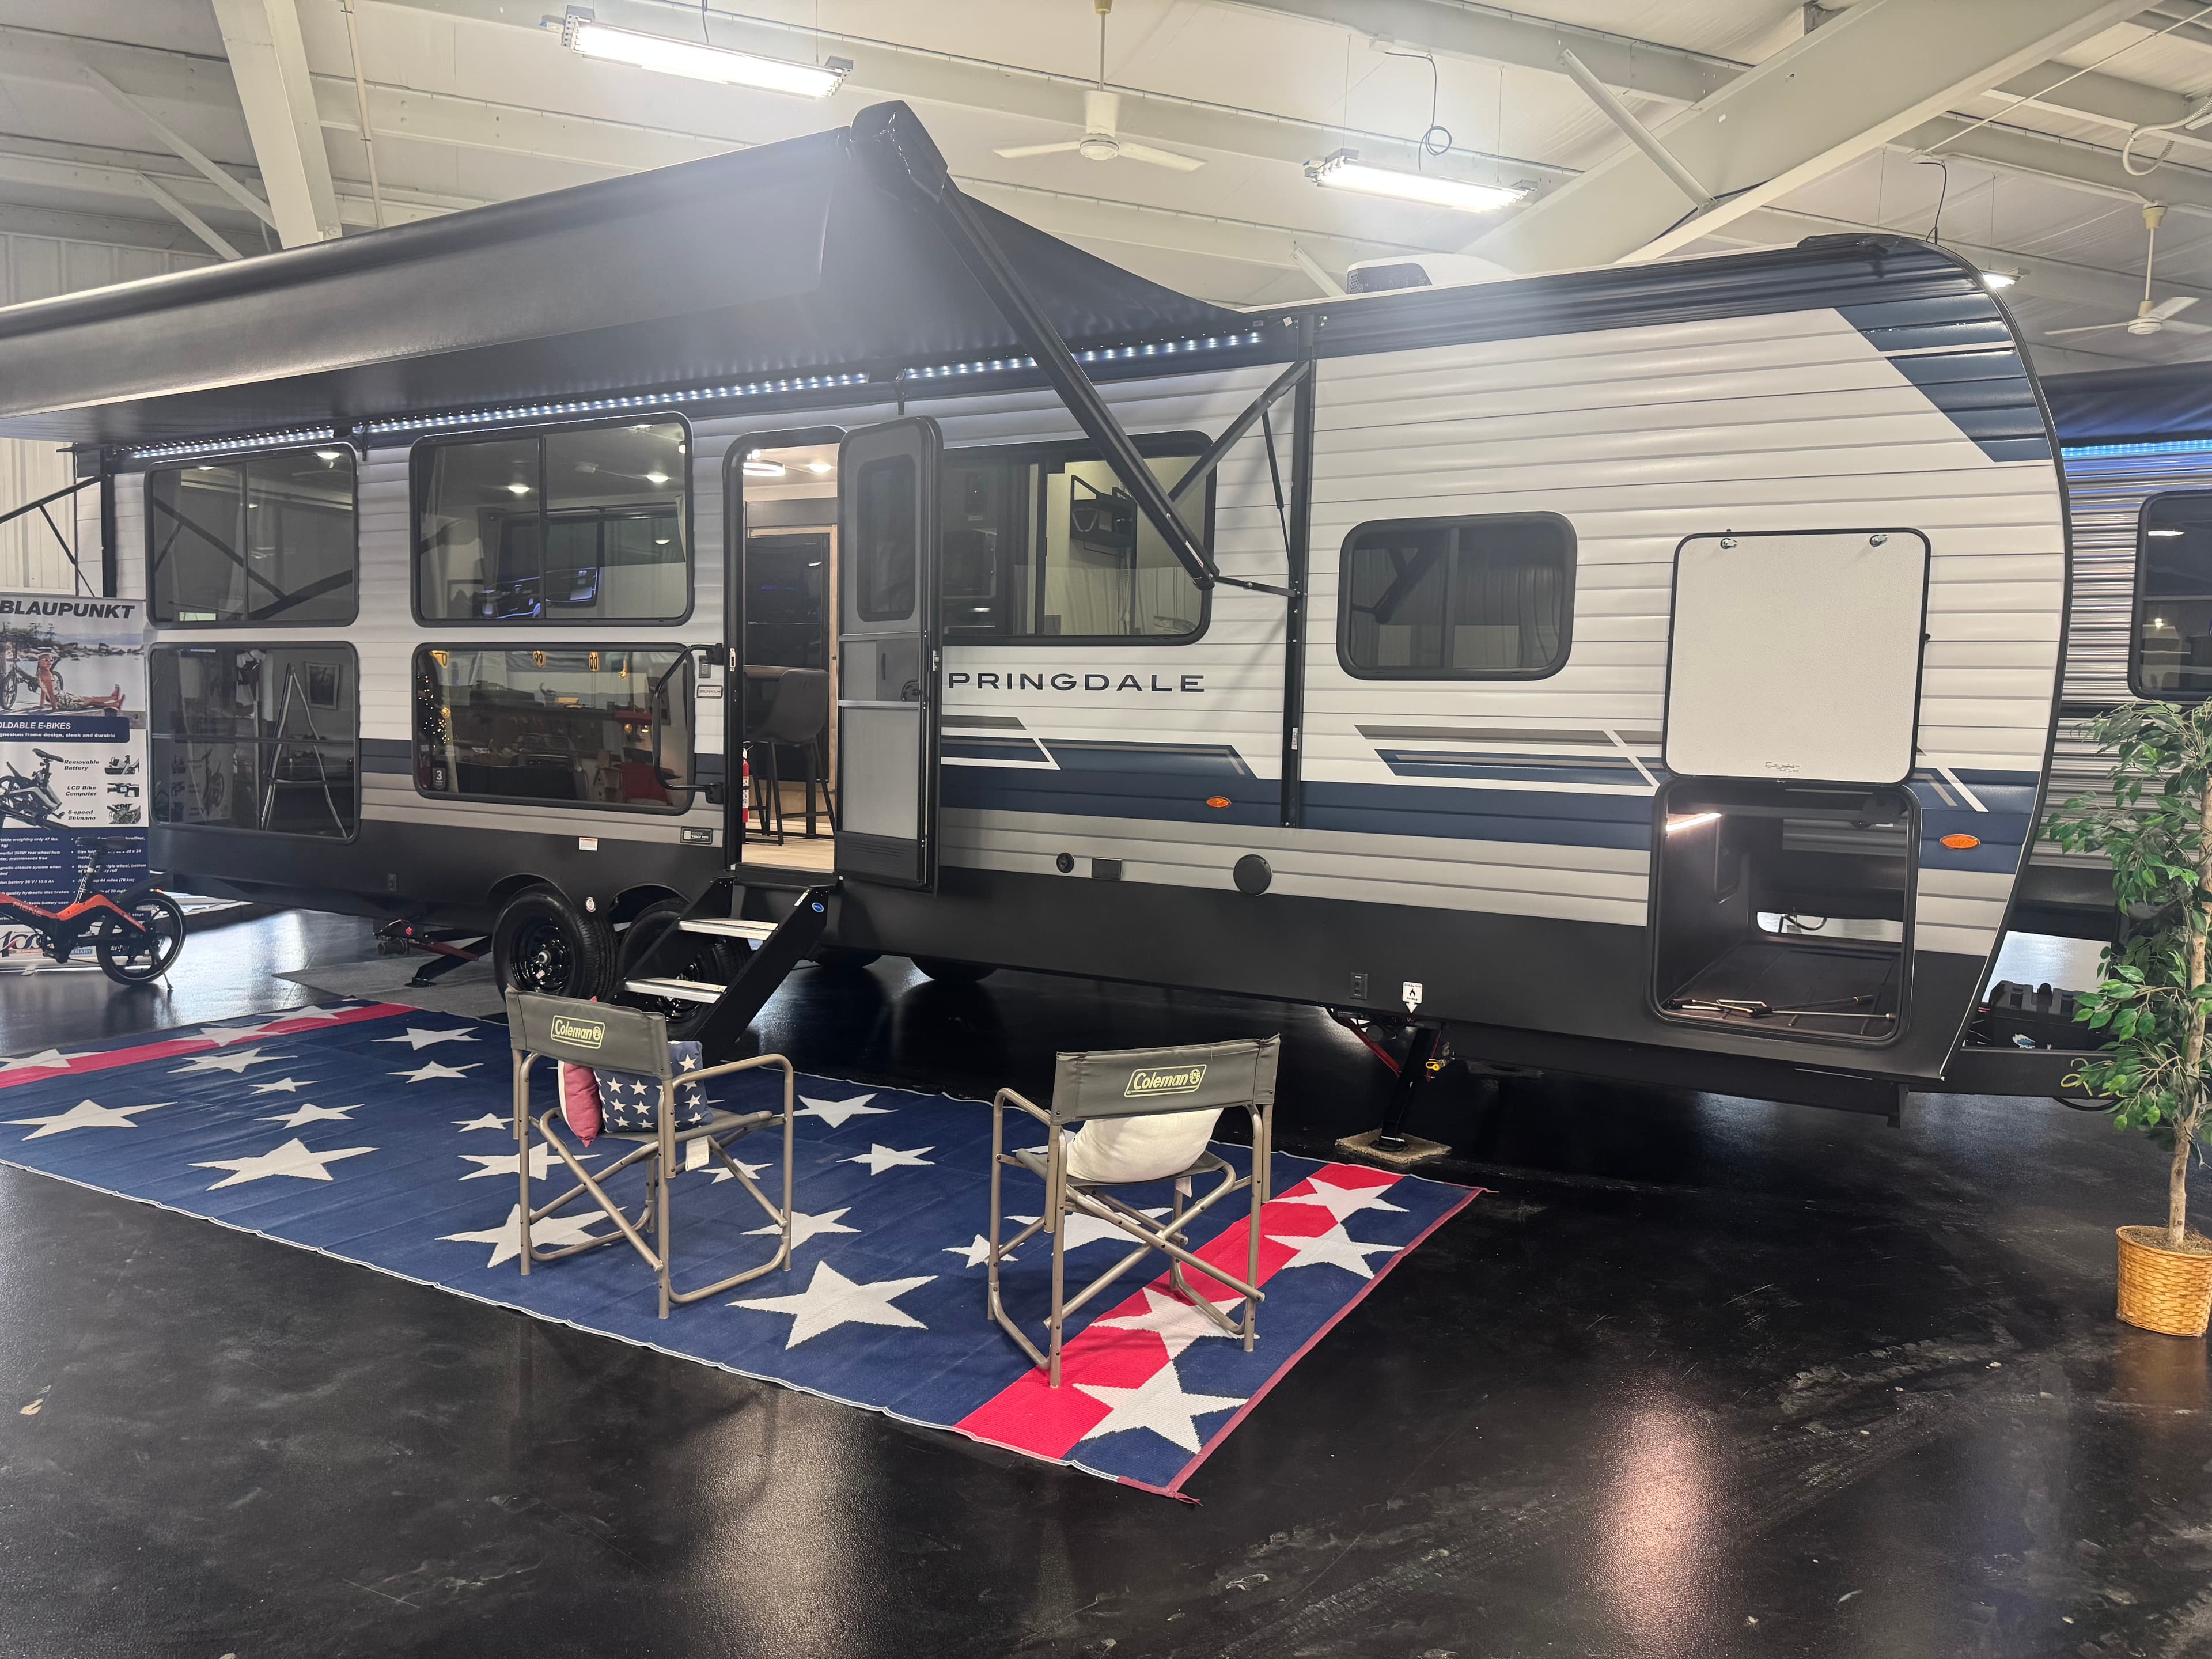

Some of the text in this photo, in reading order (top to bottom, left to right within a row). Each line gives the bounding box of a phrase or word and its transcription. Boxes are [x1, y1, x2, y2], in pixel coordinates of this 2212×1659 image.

[0, 600, 135, 619] BLAUPUNKT
[949, 673, 1205, 692] PRINGDALE
[437, 770, 442, 780] 3
[555, 1019, 592, 1040] Coleman
[1134, 1071, 1188, 1090] Coleman
